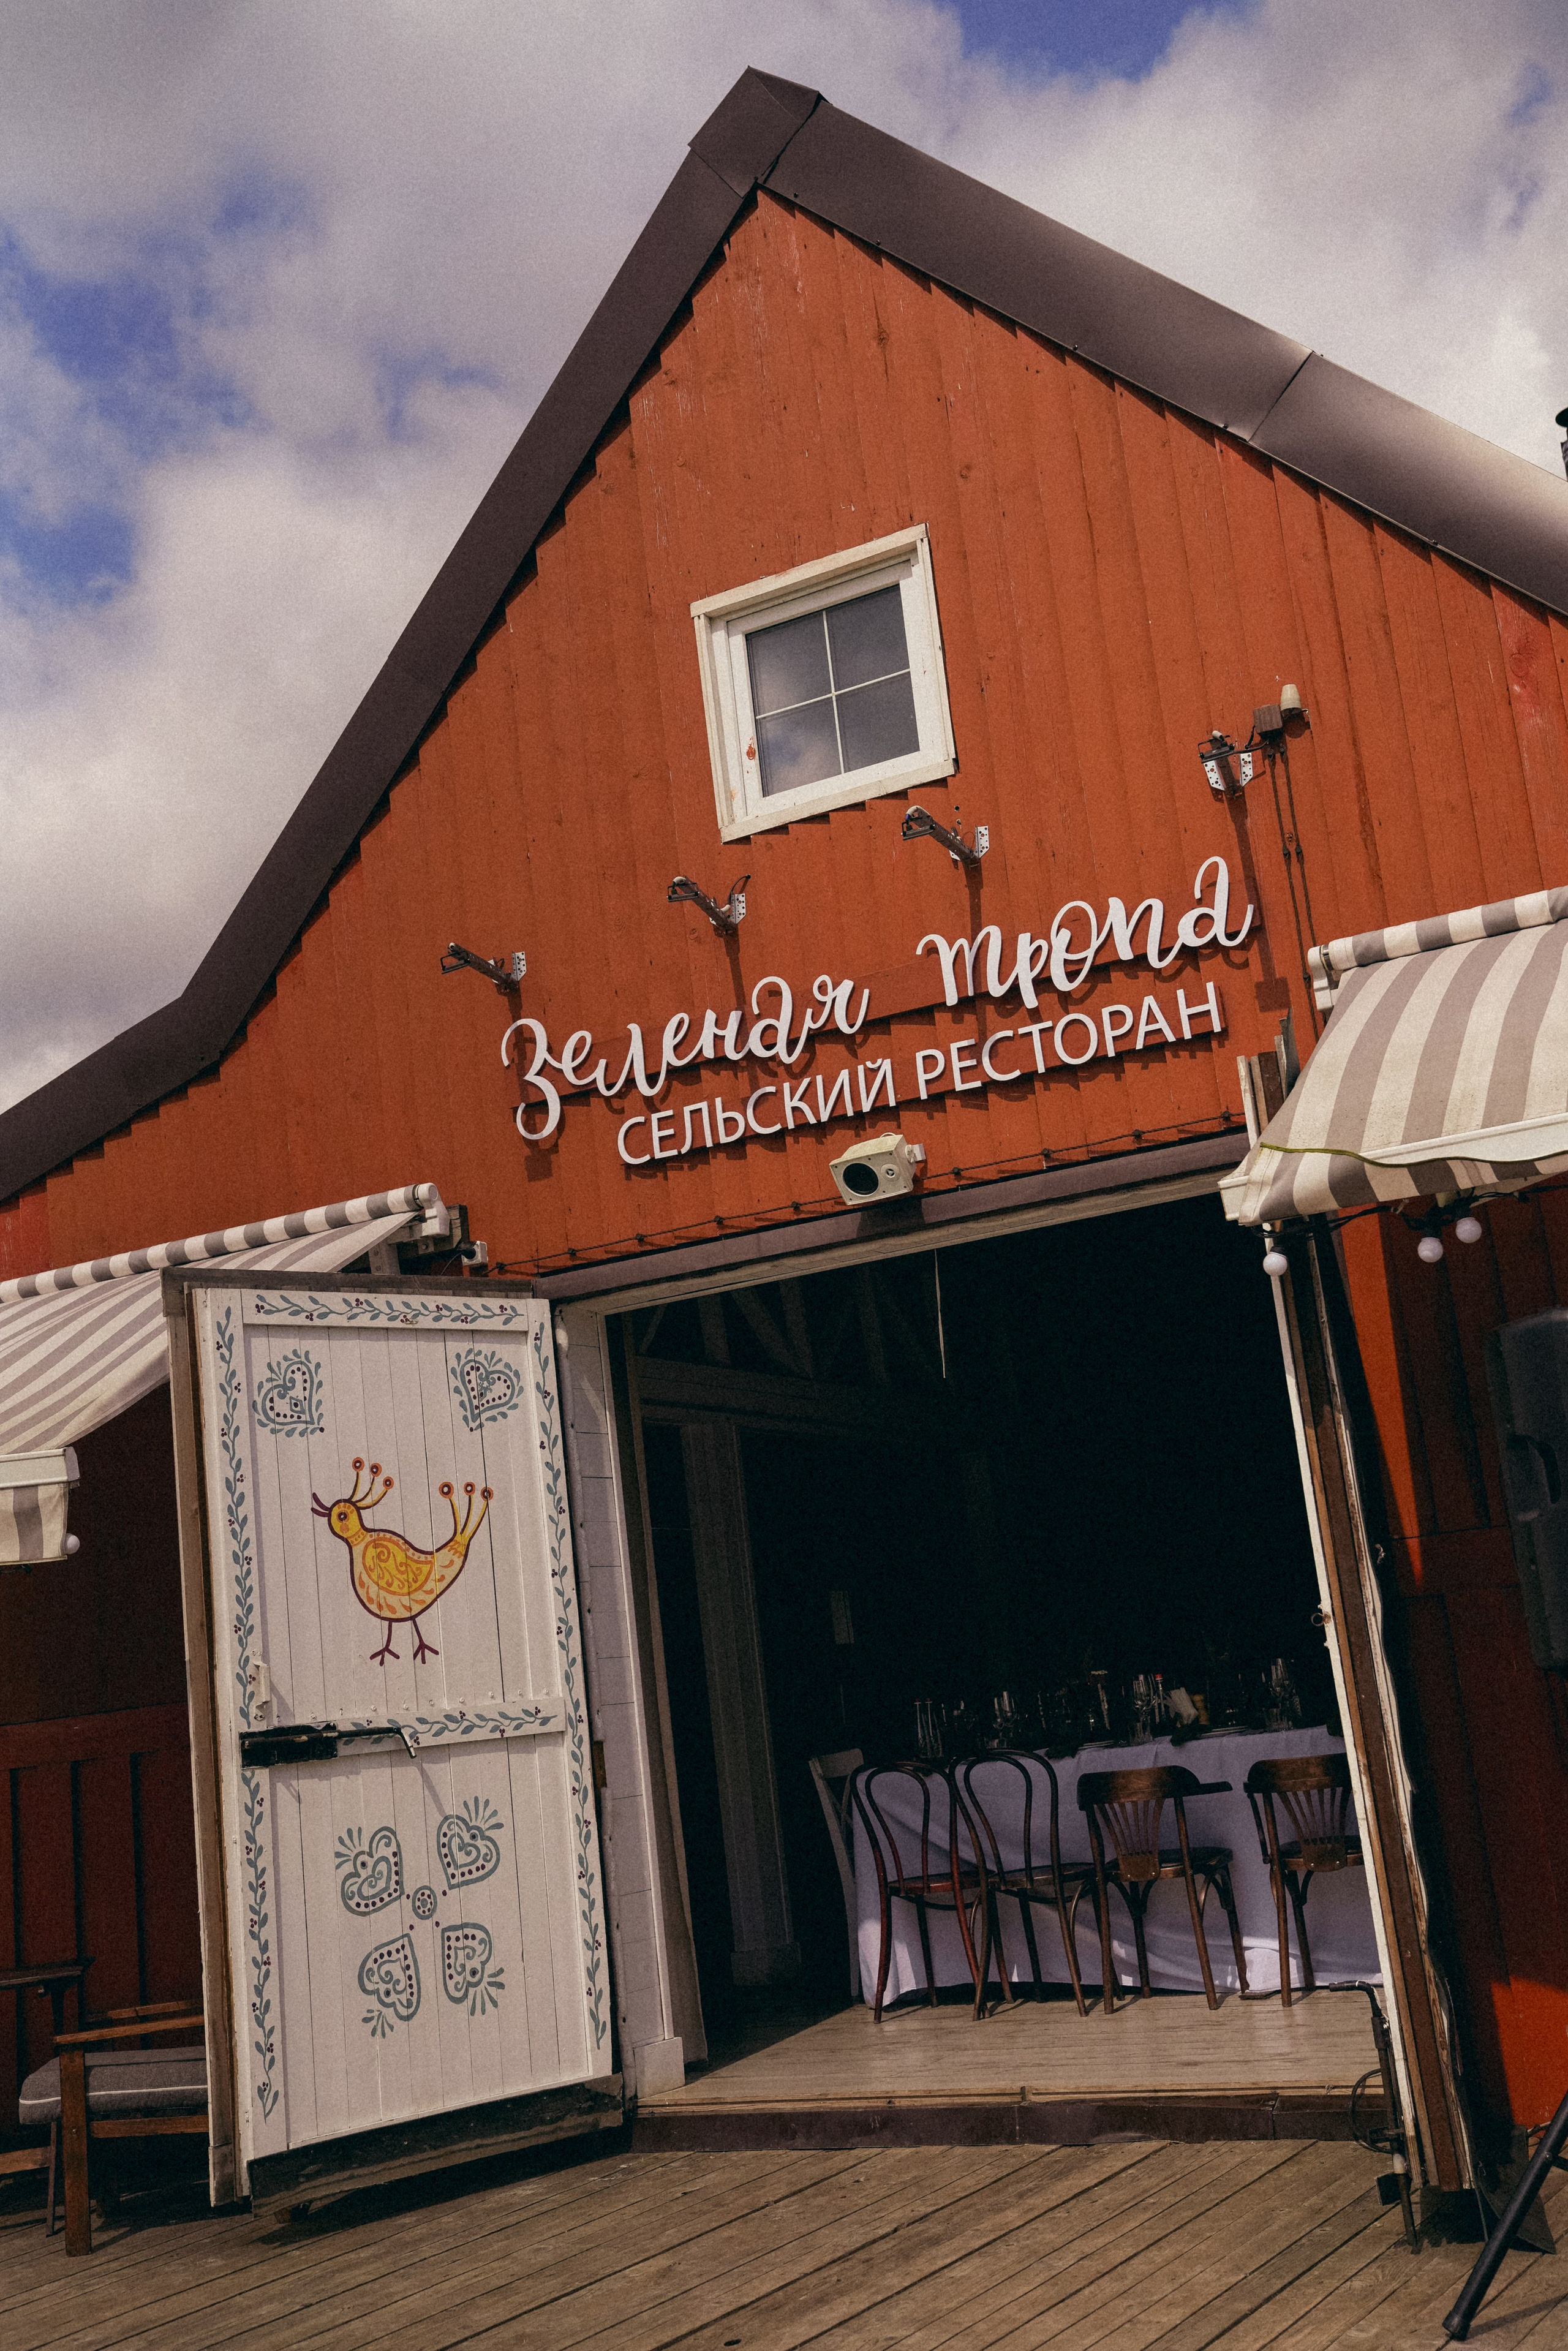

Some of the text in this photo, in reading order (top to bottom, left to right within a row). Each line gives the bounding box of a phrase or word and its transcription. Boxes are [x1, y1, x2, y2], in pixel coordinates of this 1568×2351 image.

[501, 856, 1254, 1140] Зеленая тропа
[617, 981, 1221, 1165] СЕЛЬСКИЙ РЕСТОРАН
